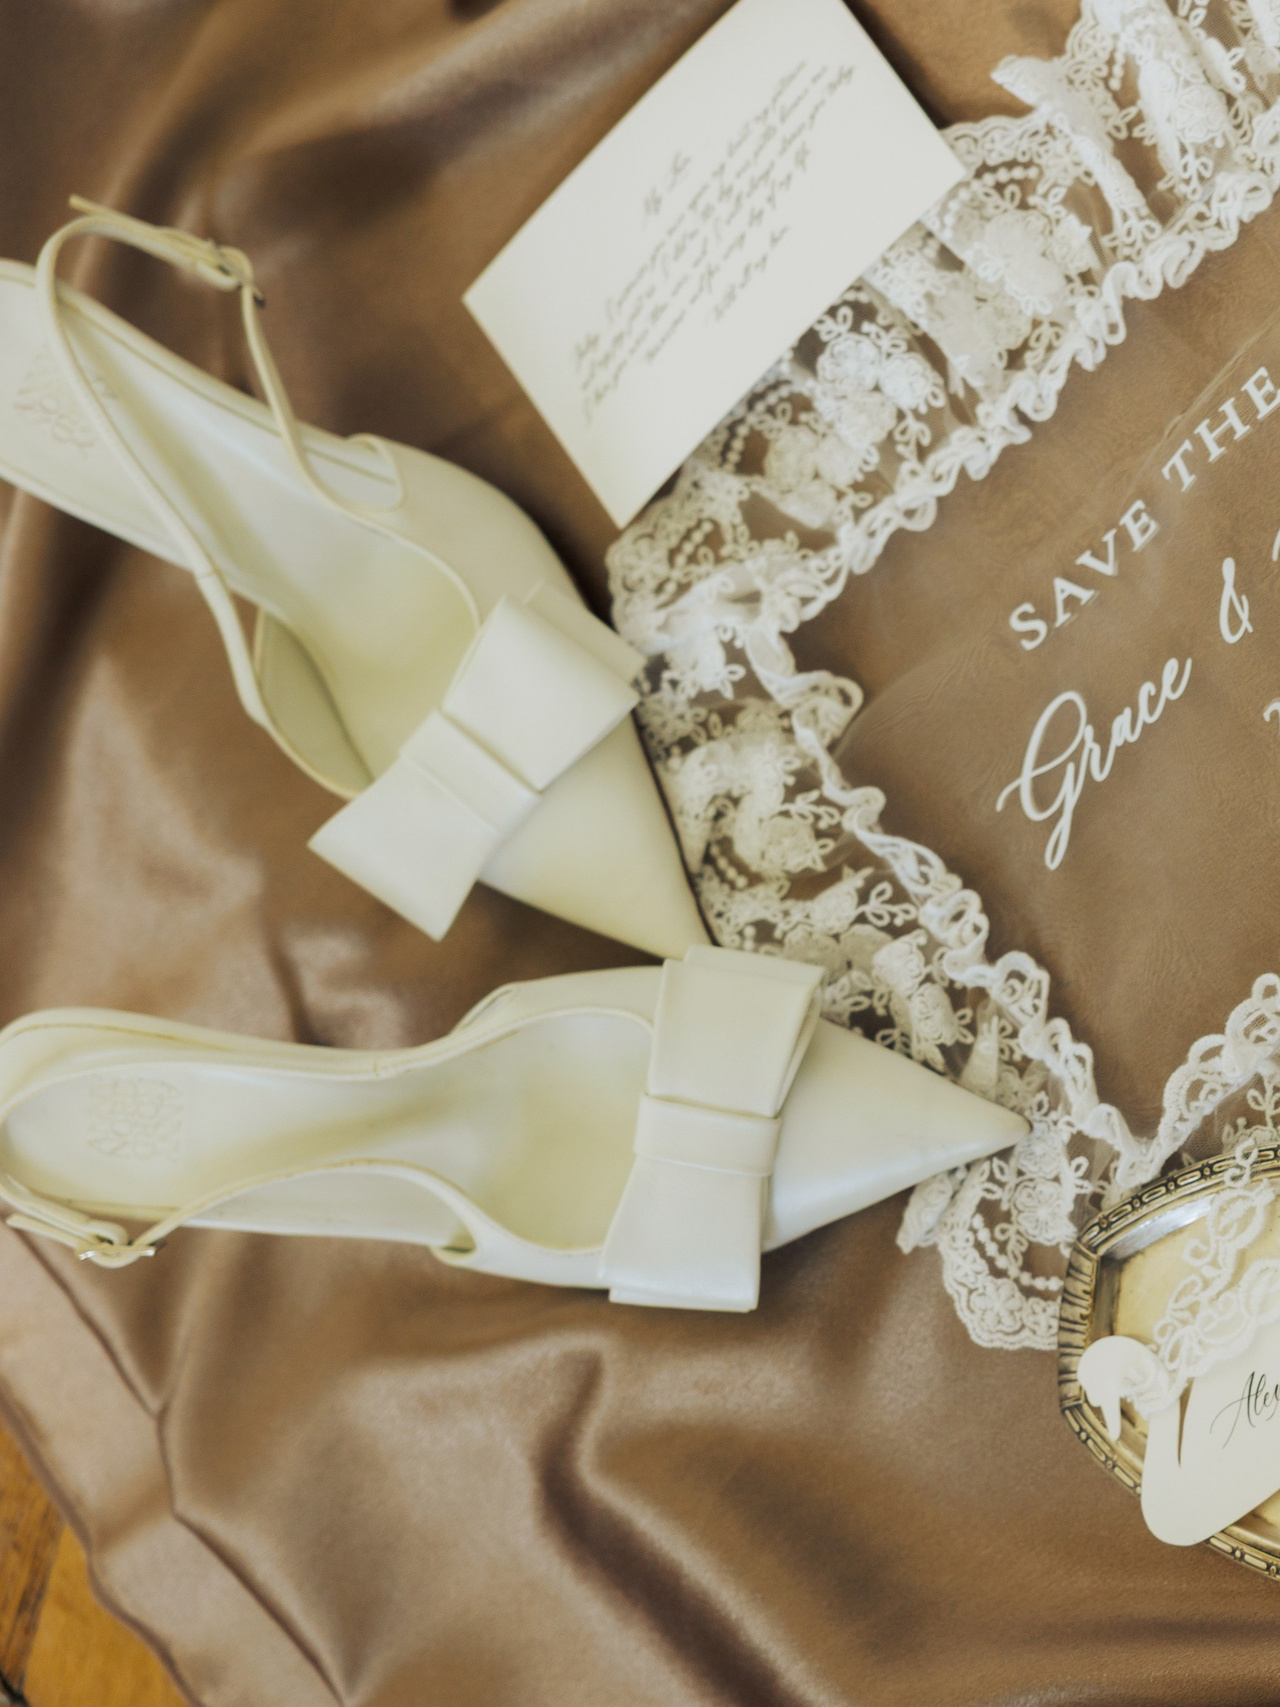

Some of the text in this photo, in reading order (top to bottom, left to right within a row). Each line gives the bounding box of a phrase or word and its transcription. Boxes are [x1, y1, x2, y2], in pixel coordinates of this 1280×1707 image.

[1008, 499, 1160, 651] SAVE
[996, 657, 1193, 870] Grace
[1219, 556, 1253, 644] &
